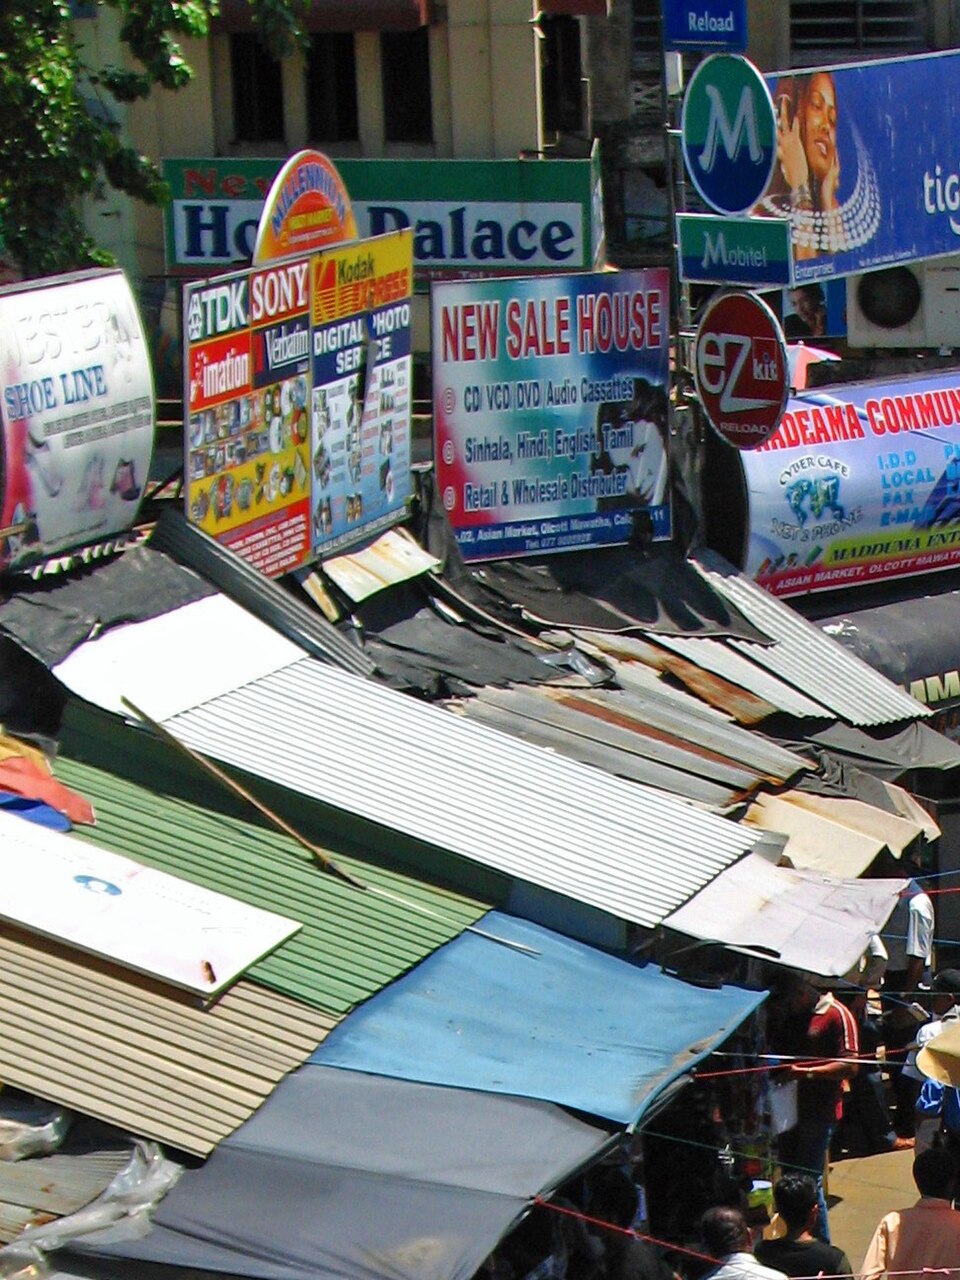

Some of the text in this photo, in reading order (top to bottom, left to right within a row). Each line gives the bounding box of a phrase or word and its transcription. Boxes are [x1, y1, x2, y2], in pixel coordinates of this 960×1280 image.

[688, 11, 735, 31] Reload
[698, 84, 764, 169] M
[367, 206, 575, 261] Palace
[702, 231, 768, 269] Mobitel
[338, 253, 375, 283] Kodak
[202, 281, 250, 335] TDK
[252, 262, 309, 320] SONY
[314, 304, 410, 356] DIGITAL HOTO
[441, 290, 662, 362] NEW SALE HOUSE
[265, 324, 310, 370] Verbatim
[203, 348, 249, 398] imation
[753, 352, 778, 381] kit
[4, 376, 57, 418] SHOE
[59, 365, 108, 404] LINE
[486, 380, 510, 410] VCD
[516, 379, 541, 409] DVD
[546, 377, 577, 406] Audio
[465, 421, 634, 464] Sinhala, Hindi, English, Tamil
[720, 422, 769, 434] RELOAD
[780, 456, 849, 486] CYBER CAFE
[877, 449, 918, 470] I.D.D
[465, 468, 629, 512] Retail & Wholesale Distributer
[881, 467, 936, 490] LOCAL
[882, 489, 915, 508] FAX
[477, 528, 503, 542] Asian
[504, 524, 539, 539] Market,
[831, 534, 921, 563] MADDUMA
[776, 574, 812, 591] ASIAN
[814, 565, 866, 583] MARKET,
[868, 556, 916, 574] OLCOTT
